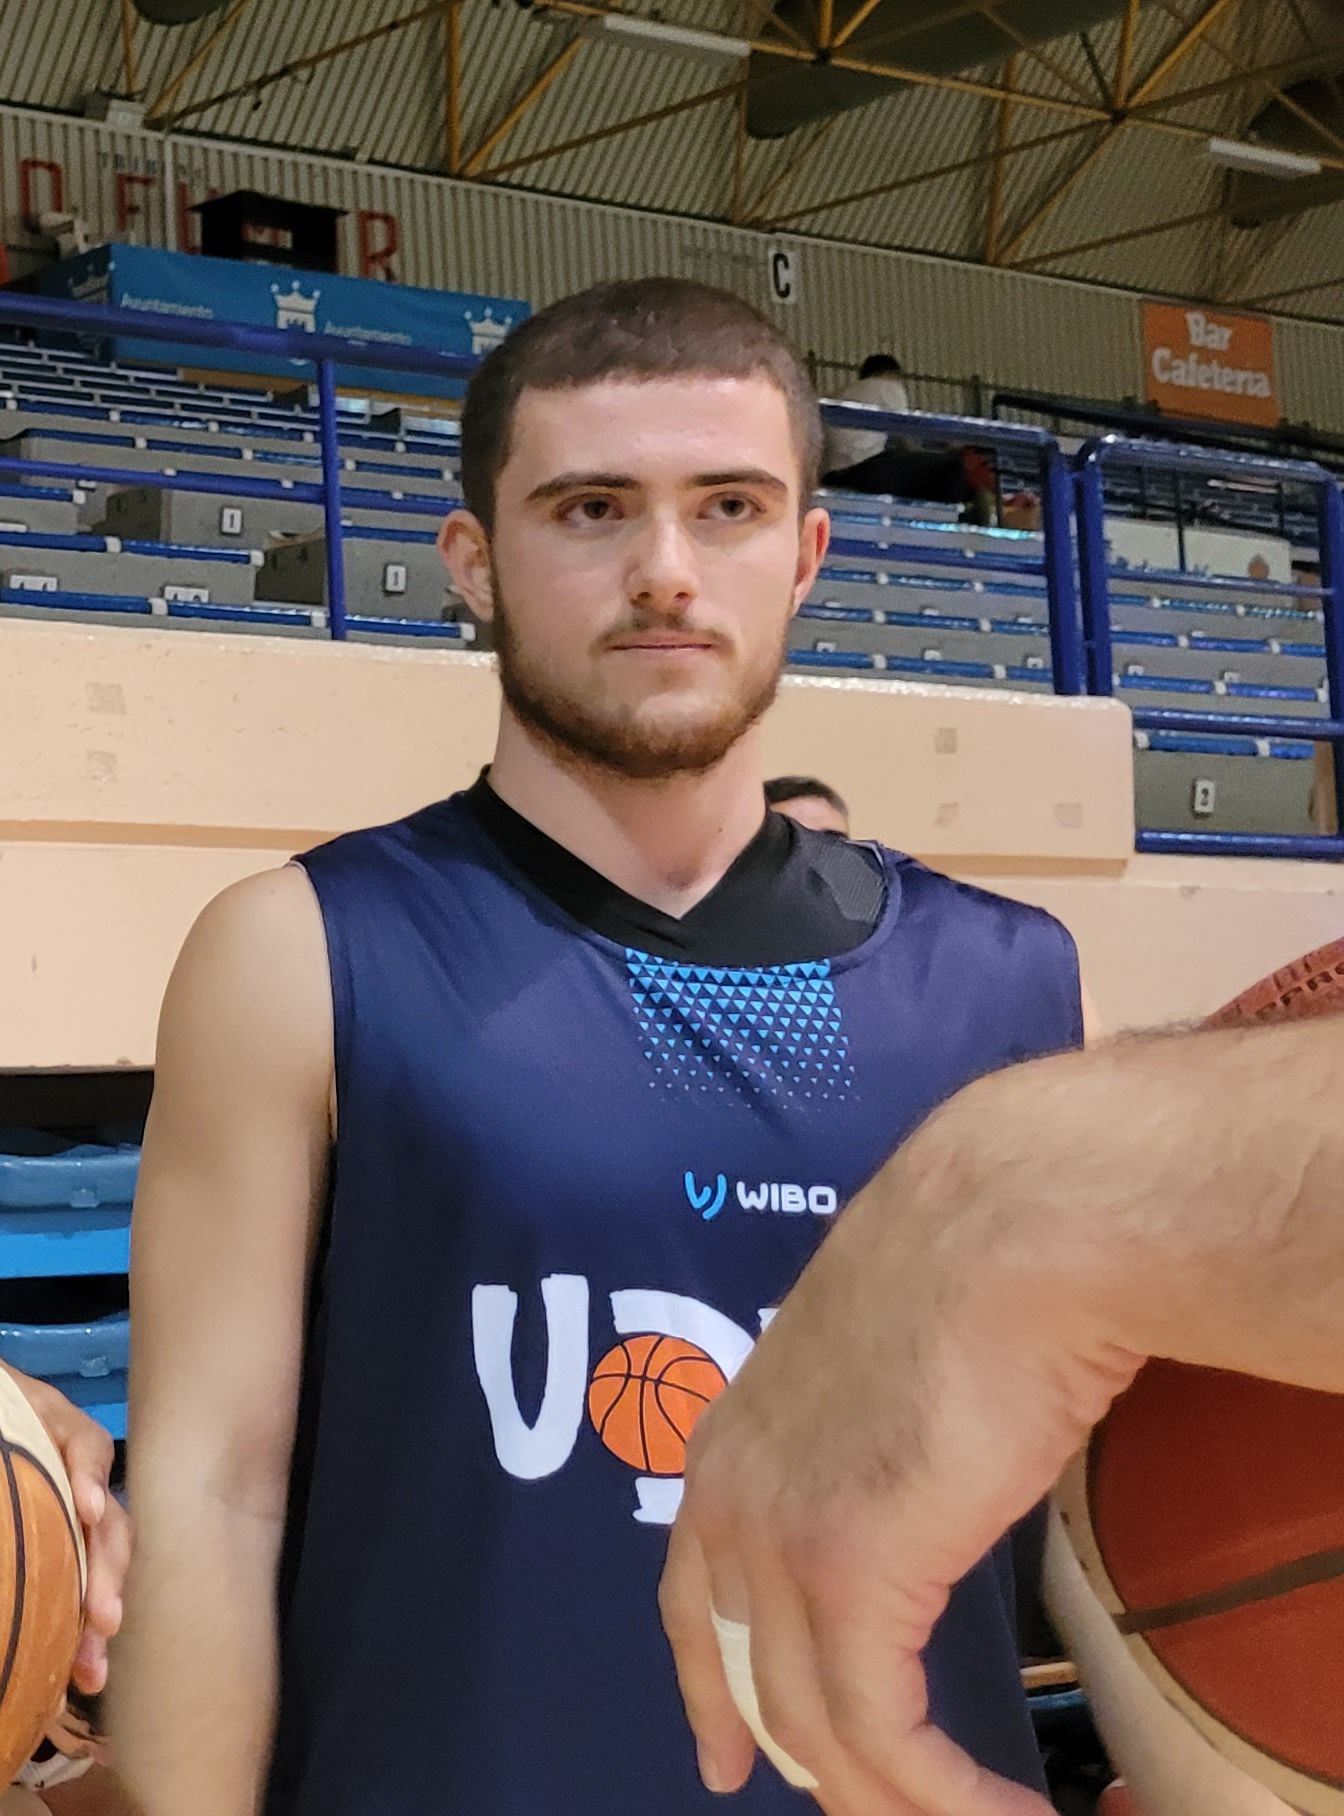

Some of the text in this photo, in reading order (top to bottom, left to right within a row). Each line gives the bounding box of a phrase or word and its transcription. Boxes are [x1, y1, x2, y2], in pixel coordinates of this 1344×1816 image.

[772, 252, 791, 299] C
[1184, 309, 1233, 352] Bar
[736, 1180, 839, 1216] WIBO
